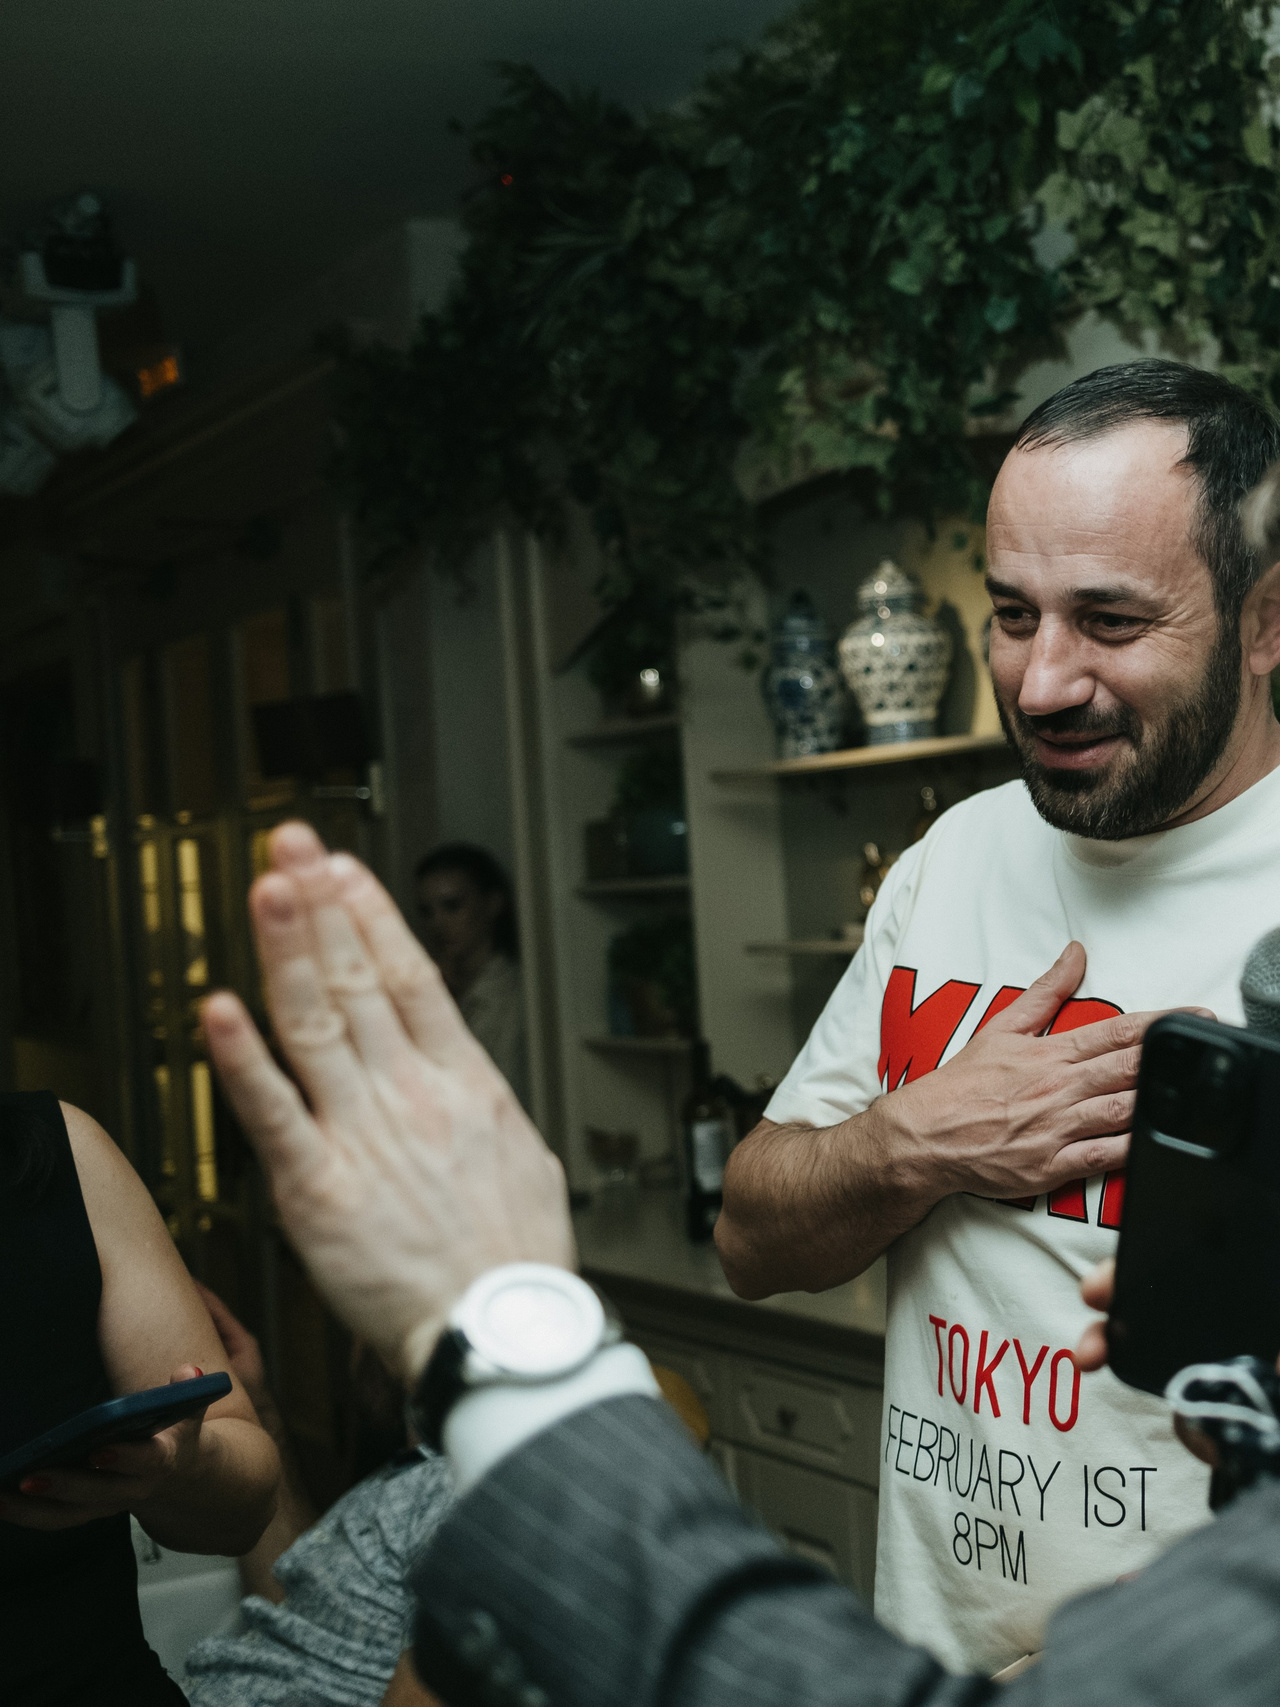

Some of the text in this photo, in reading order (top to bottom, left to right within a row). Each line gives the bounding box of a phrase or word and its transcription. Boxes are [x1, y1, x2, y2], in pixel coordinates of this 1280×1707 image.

[929, 1314, 1081, 1432] TOKYO
[885, 1404, 1061, 1521] FEBRUARY
[953, 1512, 1027, 1585] 8PM
